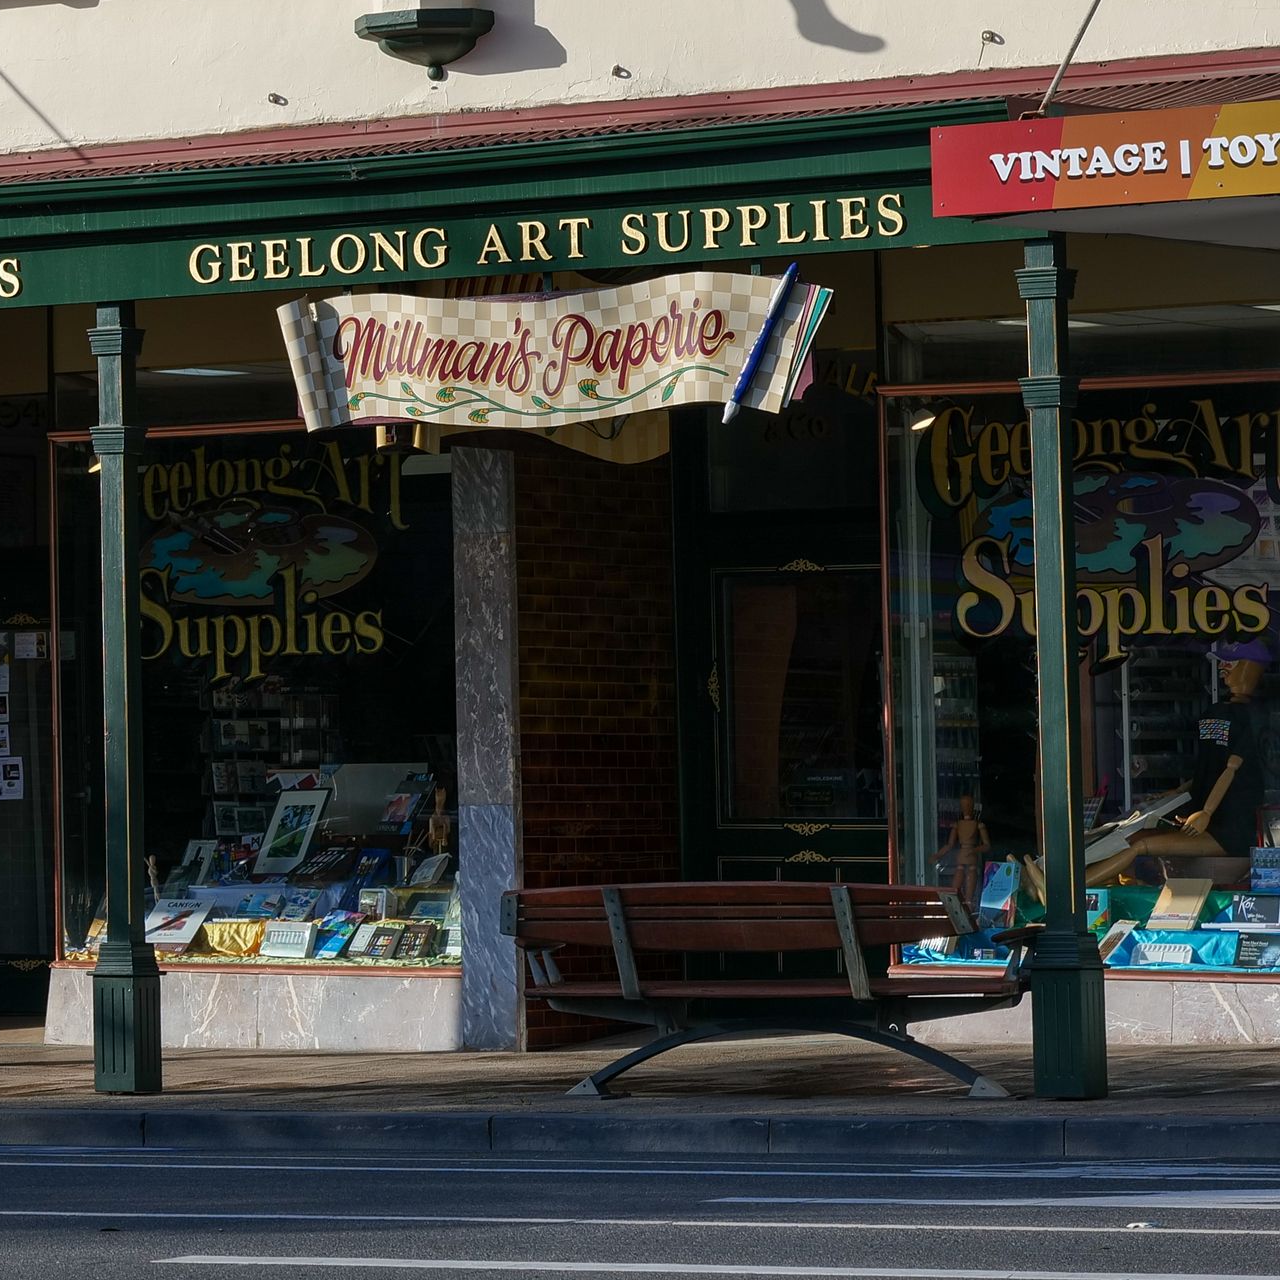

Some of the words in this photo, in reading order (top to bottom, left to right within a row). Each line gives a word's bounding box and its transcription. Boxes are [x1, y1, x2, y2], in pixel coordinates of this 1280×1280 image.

[989, 141, 1168, 183] VINTAGE
[1202, 133, 1280, 167] TOY
[189, 227, 449, 285] GEELONG
[476, 217, 592, 265] ART
[621, 193, 905, 256] SUPPLIES
[333, 314, 542, 396] Millman's
[544, 298, 735, 397] Paperie
[142, 443, 310, 521] eelong
[300, 441, 410, 530] Art
[929, 403, 1162, 508] Geeng
[1168, 399, 1280, 505] Ar
[140, 562, 386, 684] Supplies
[167, 901, 203, 909] CANSON
